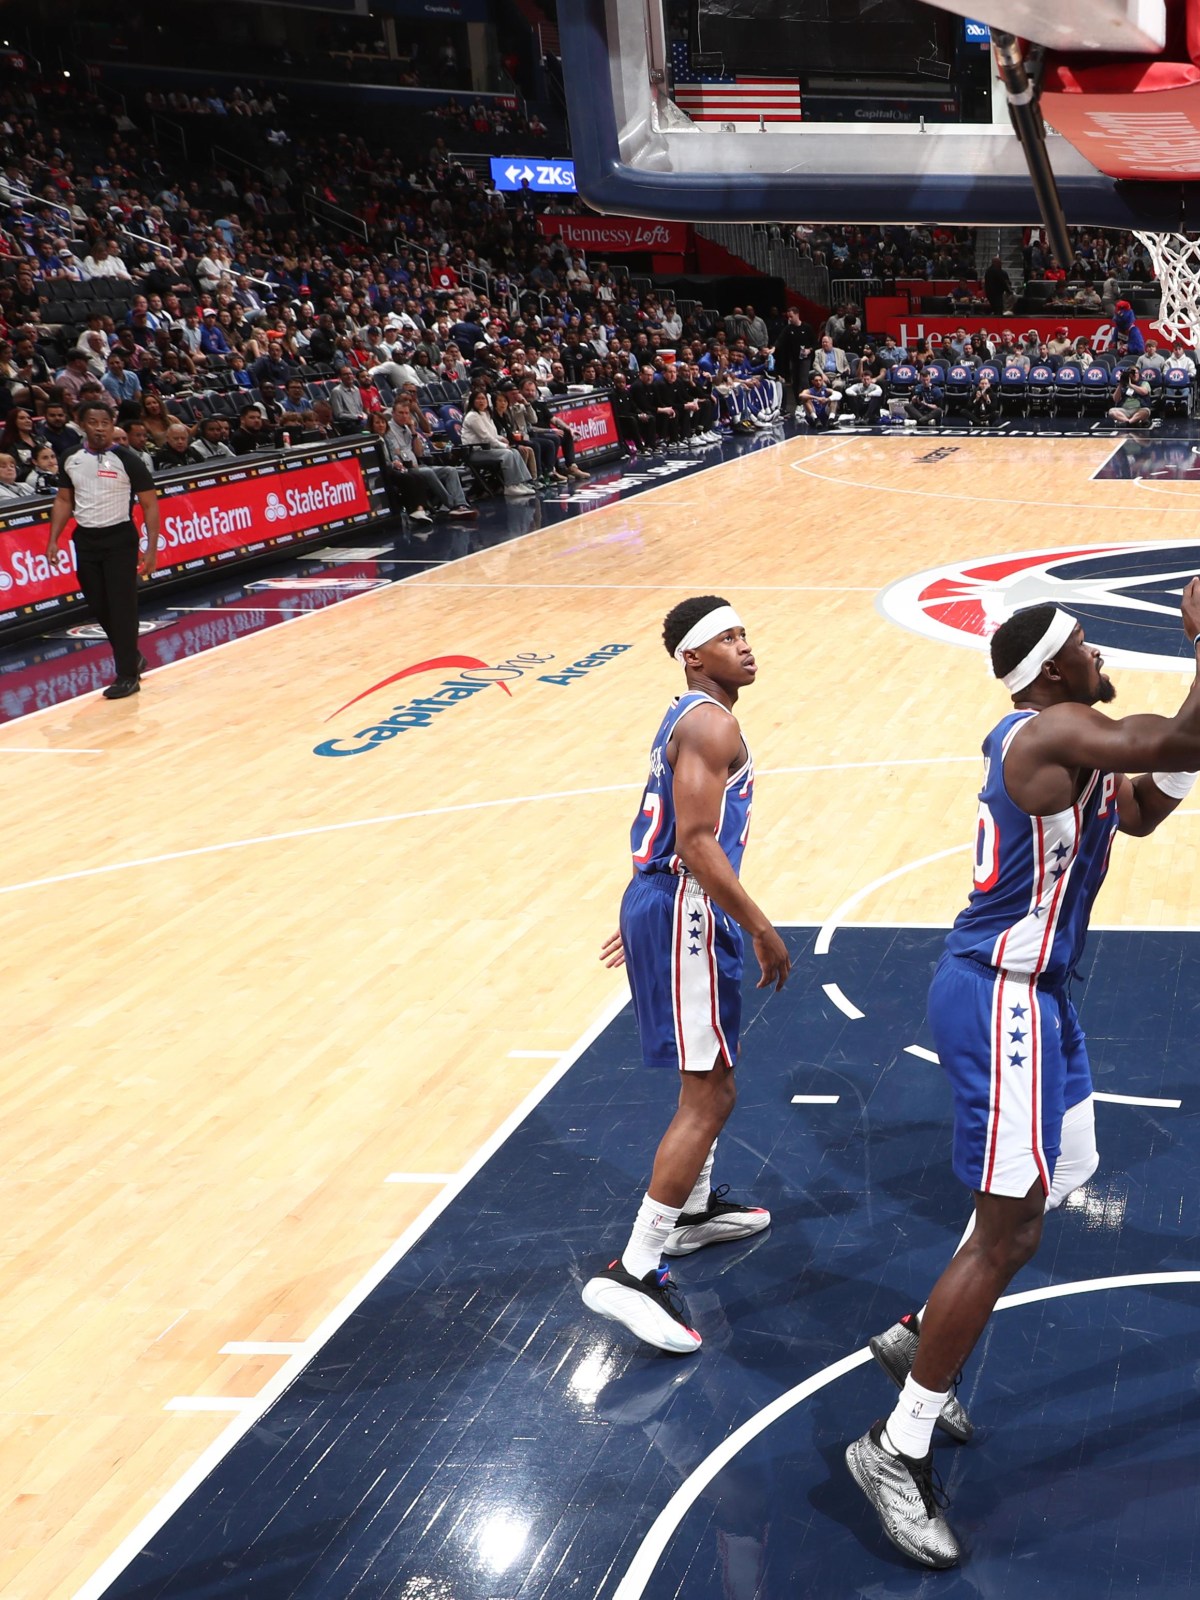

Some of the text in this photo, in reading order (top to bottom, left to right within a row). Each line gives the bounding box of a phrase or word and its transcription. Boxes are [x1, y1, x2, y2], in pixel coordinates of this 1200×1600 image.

[559, 224, 670, 246] Hennessy Lofts
[285, 481, 356, 517] StateFarm
[165, 506, 252, 548] StateFarm
[537, 643, 634, 687] Arena
